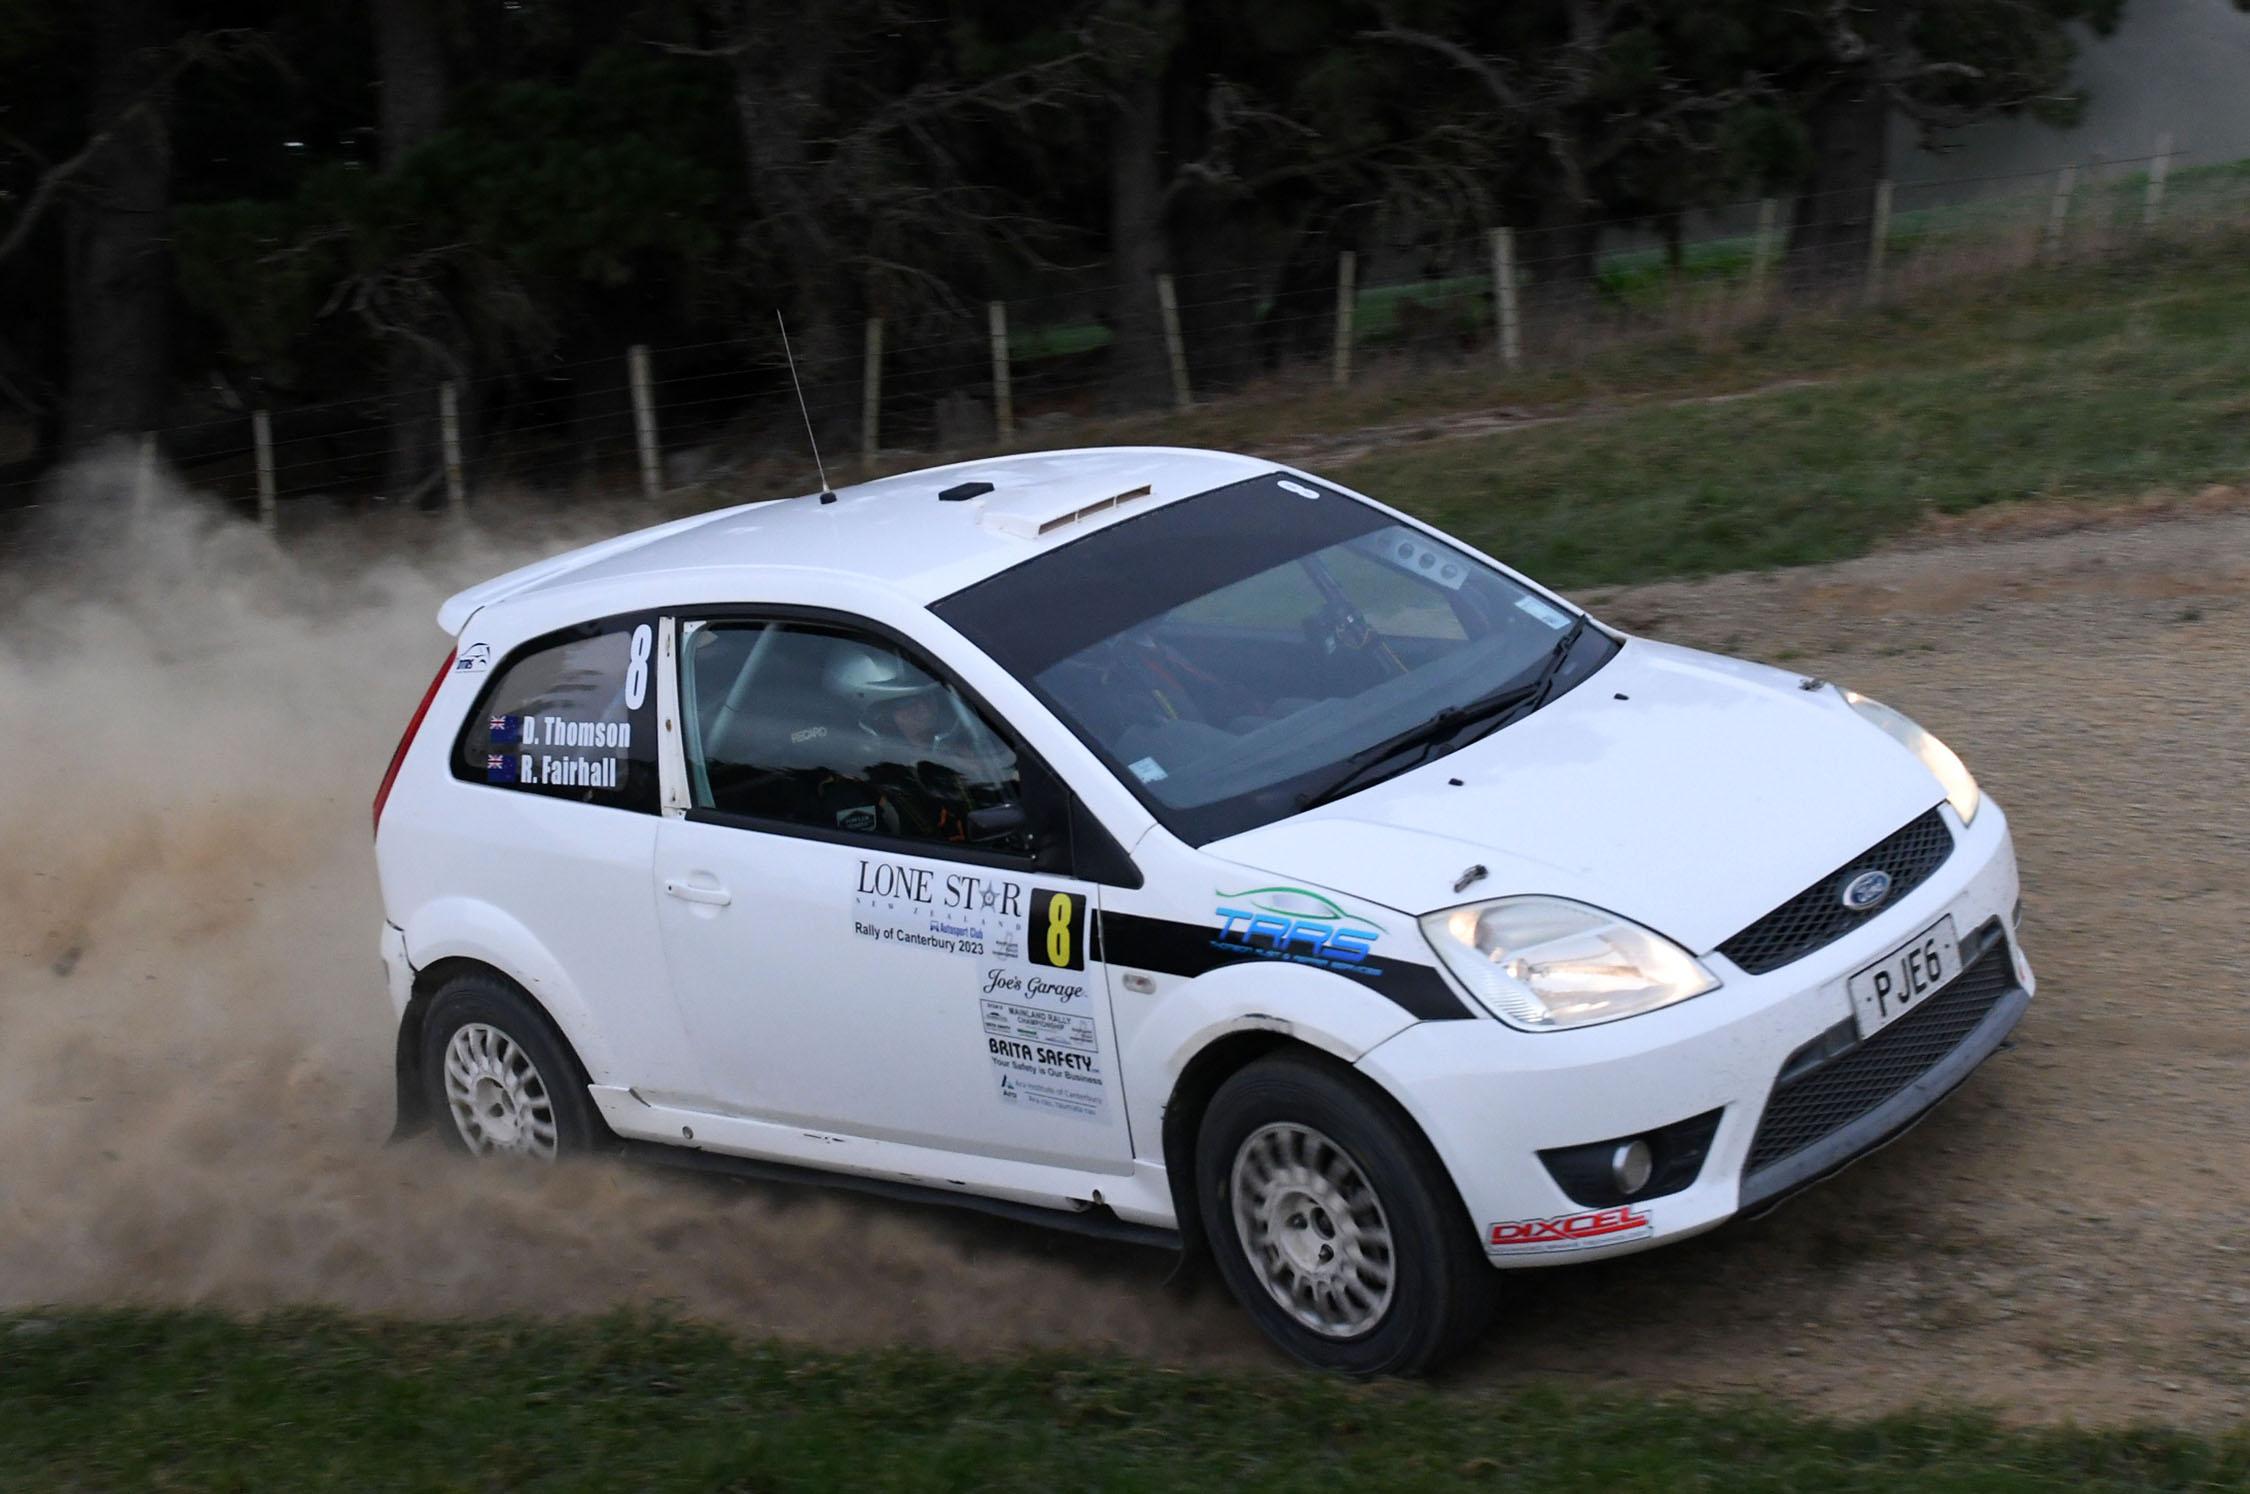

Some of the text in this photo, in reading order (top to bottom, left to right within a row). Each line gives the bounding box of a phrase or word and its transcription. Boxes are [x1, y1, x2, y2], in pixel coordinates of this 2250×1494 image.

[625, 624, 652, 710] 8
[522, 715, 631, 748] D. Thomson
[520, 754, 616, 787] R. Fairhall
[857, 860, 934, 903] LONE
[855, 922, 880, 940] Rally
[883, 928, 894, 939] of
[896, 929, 955, 953] Canterbury
[958, 940, 984, 955] 2023
[1047, 893, 1072, 967] 8
[983, 968, 1084, 1004] Joe's Garage
[1874, 938, 1942, 1017] PJE6
[988, 1037, 1092, 1072] BRITA SAFETY
[992, 1057, 1010, 1067] Your
[1012, 1061, 1037, 1075] Safety
[1047, 1067, 1062, 1078] Our
[1064, 1071, 1103, 1086] Business
[1491, 1205, 1647, 1241] DIXCEL
